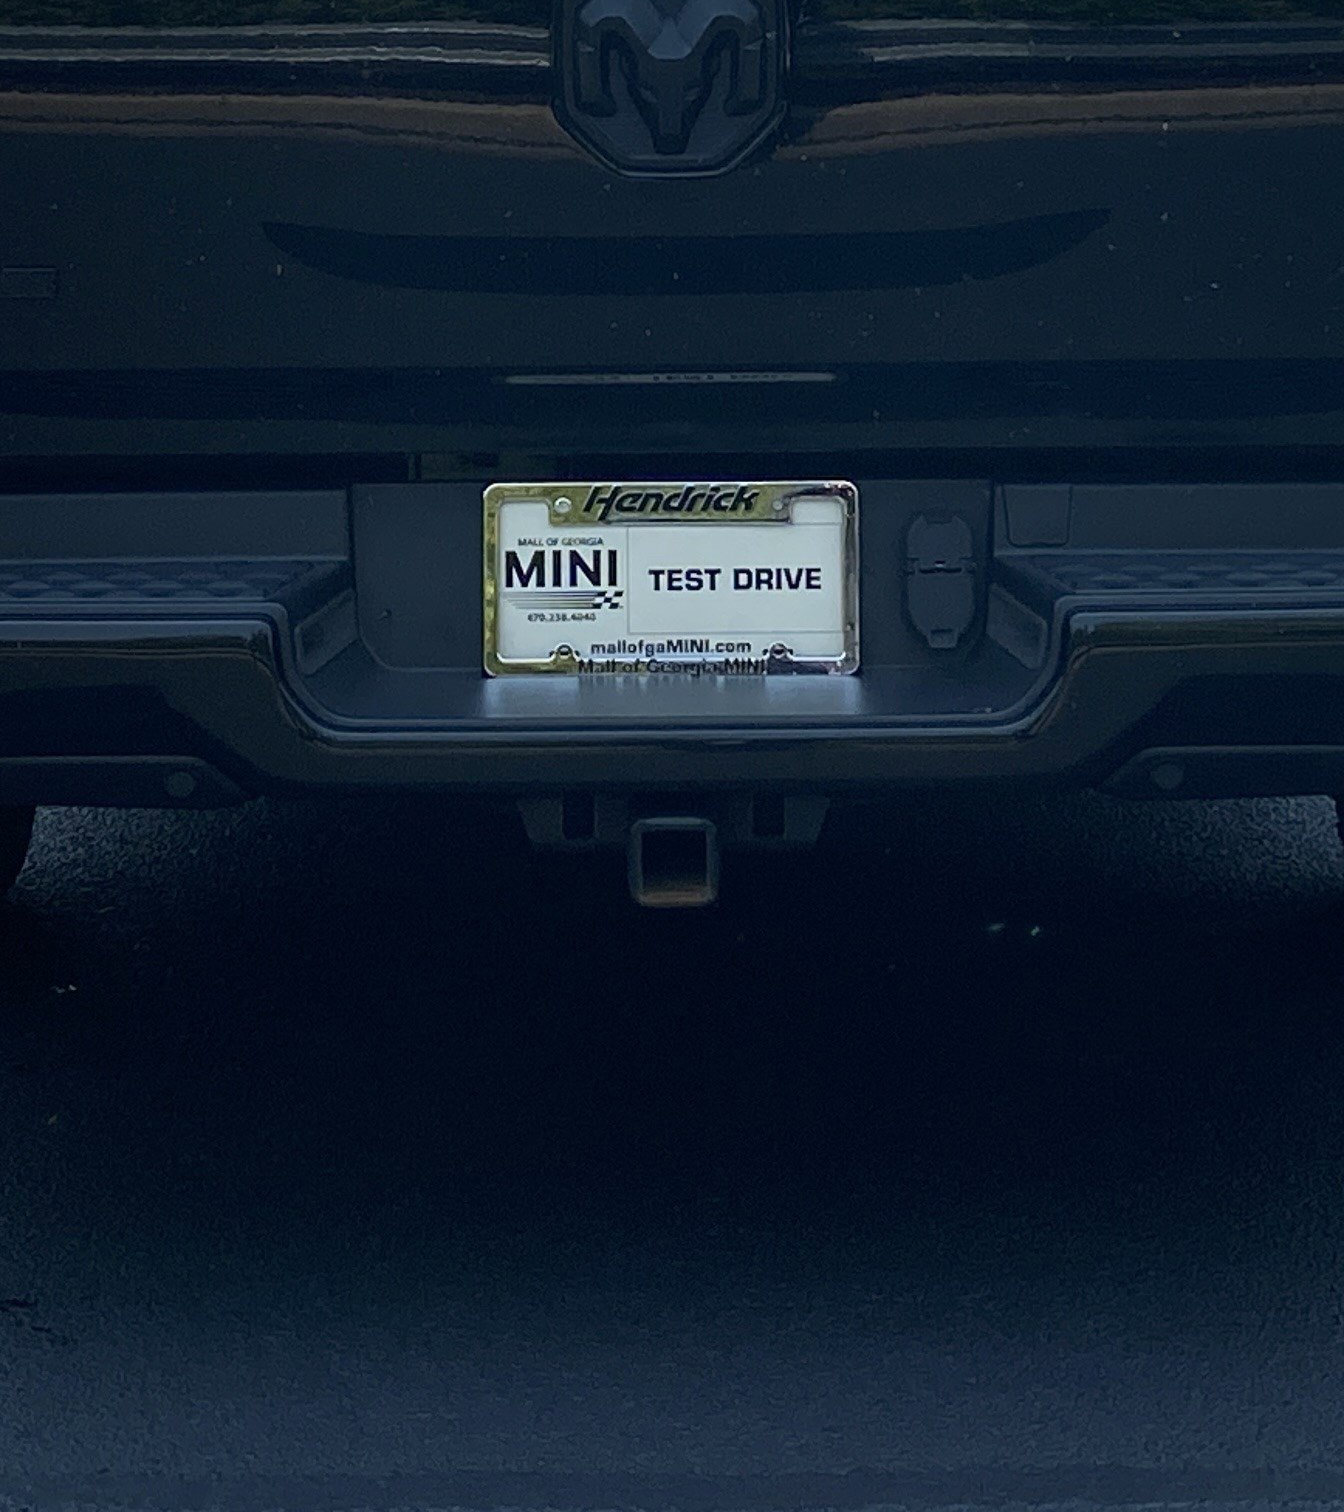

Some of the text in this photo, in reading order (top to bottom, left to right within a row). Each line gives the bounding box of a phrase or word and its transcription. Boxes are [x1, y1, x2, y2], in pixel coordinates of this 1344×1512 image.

[582, 484, 760, 521] Hendrick
[517, 537, 604, 546] MALL OF GEORGIA
[505, 550, 617, 588] MINI
[648, 567, 822, 591] TEST DRIVE
[590, 639, 752, 657] mallofgaMINI.com
[578, 658, 618, 674] Mall
[723, 658, 766, 674] MINI
